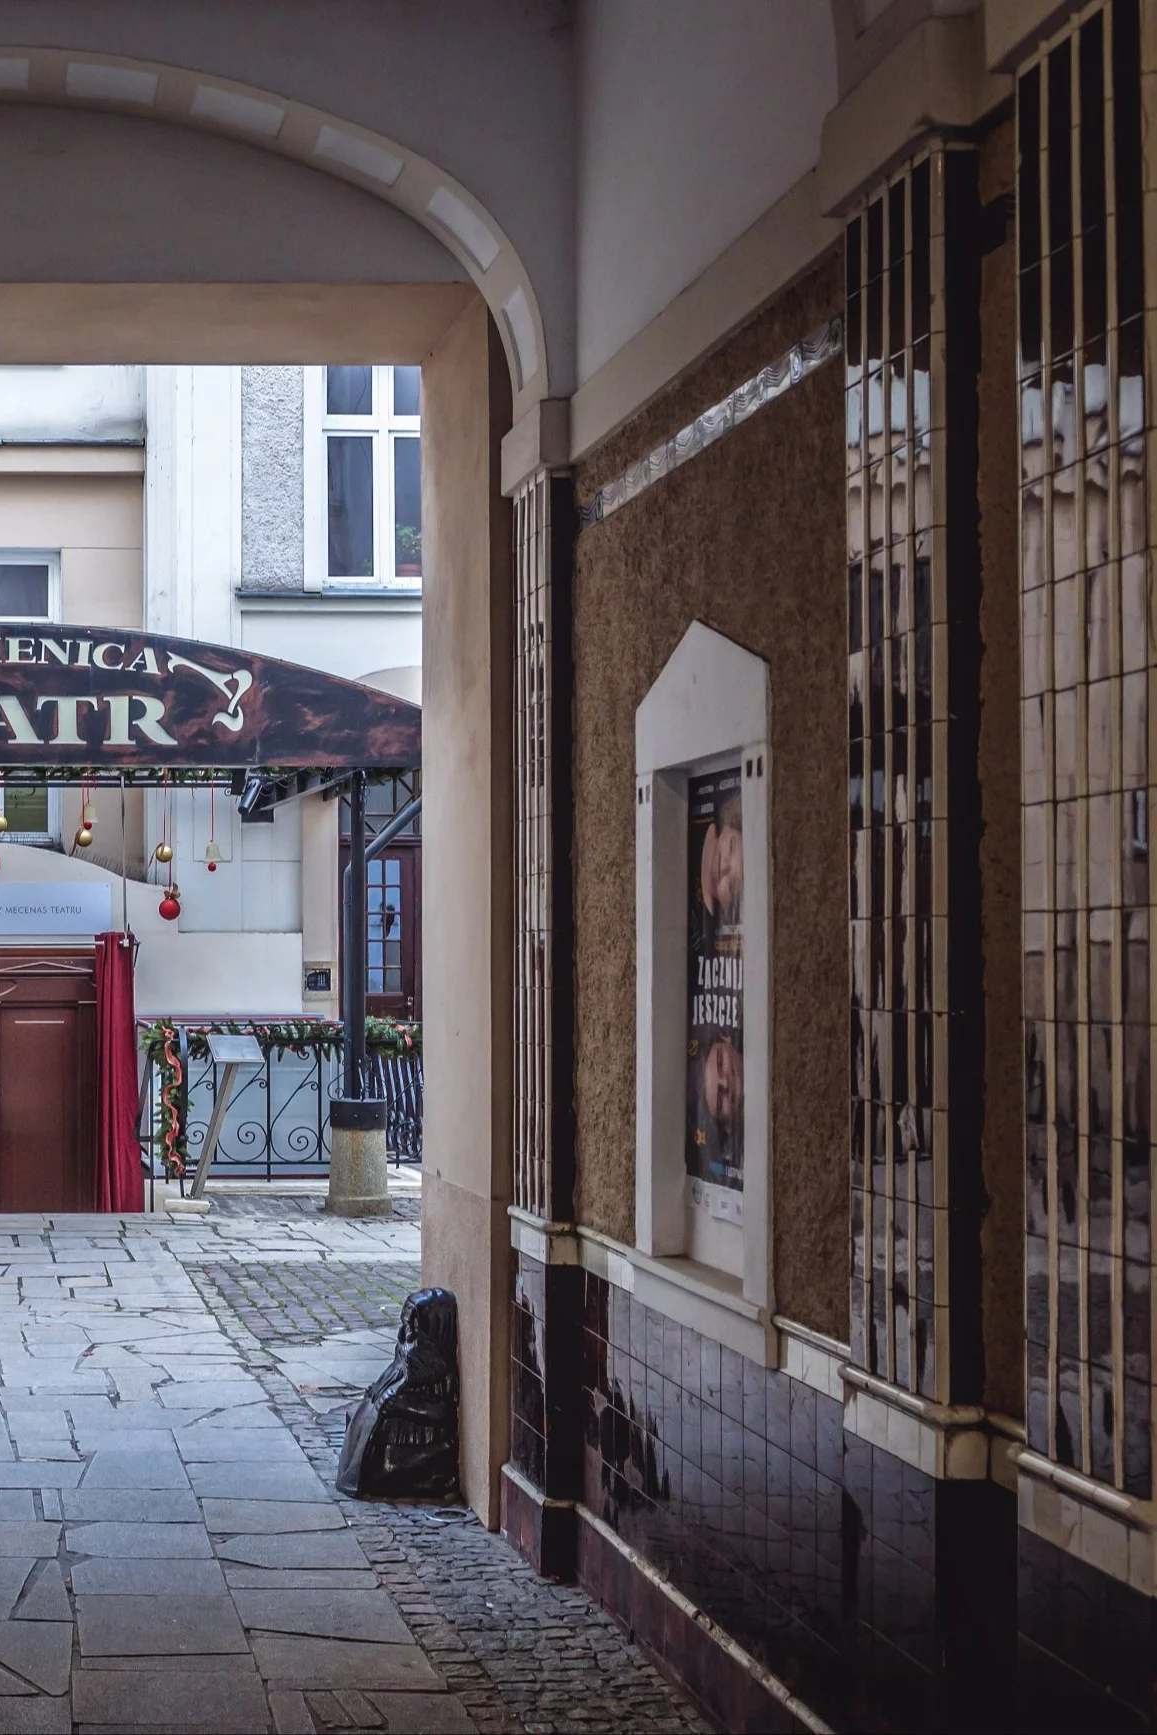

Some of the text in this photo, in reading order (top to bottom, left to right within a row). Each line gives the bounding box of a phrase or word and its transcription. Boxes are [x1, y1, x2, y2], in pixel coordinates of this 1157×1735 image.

[5, 906, 47, 914] MECENAS
[50, 906, 82, 914] TEATRU
[692, 995, 737, 1027] JESZCZE
